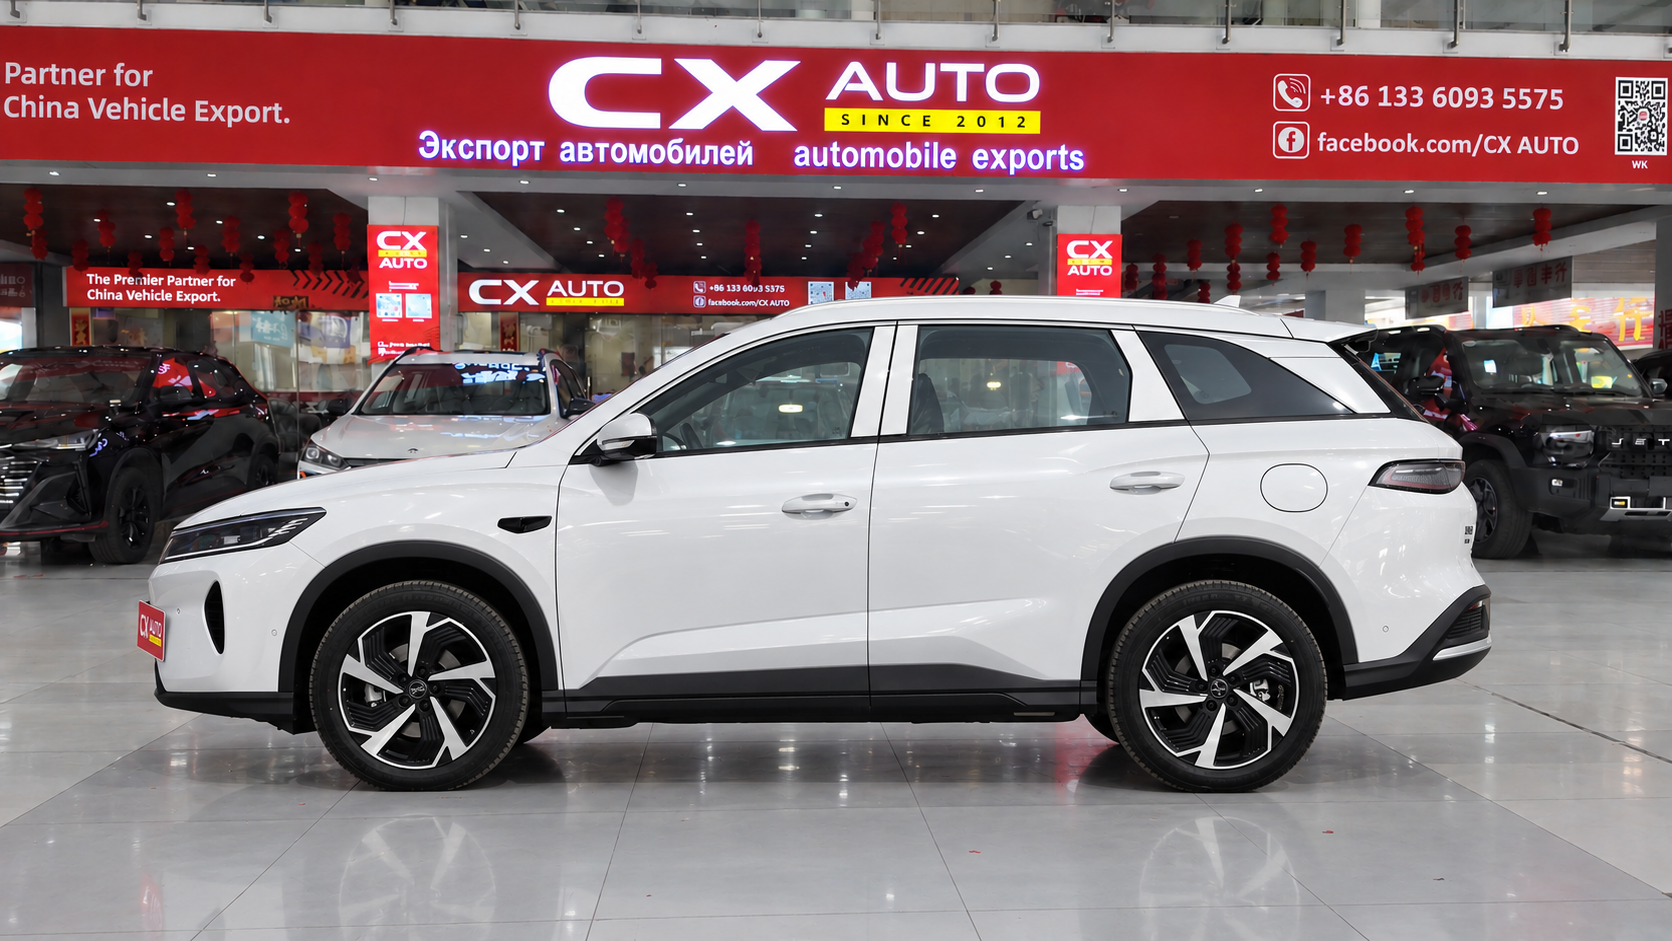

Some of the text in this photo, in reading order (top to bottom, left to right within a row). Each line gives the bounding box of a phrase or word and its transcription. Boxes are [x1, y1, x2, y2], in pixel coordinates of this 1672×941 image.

[5, 62, 154, 87] Partner for
[548, 56, 1040, 132] CX AUTO
[1321, 85, 1564, 110] +86 133 6093 5575
[3, 95, 290, 128] China Vehicle Export.
[841, 113, 1027, 128] SINCE 2012
[418, 130, 754, 167] Экспорт автомобилей
[1317, 132, 1579, 157] facebook.com/CX AUTO
[794, 141, 1085, 176] automobile exports
[1631, 160, 1648, 169] WK
[376, 230, 427, 250] CX
[1066, 240, 1113, 259] CX
[378, 257, 428, 269] AUTO
[1067, 265, 1113, 276] AUTO
[87, 273, 236, 287] The Premier Partner for
[709, 284, 725, 293] +86
[726, 284, 741, 293] 133
[87, 288, 221, 304] China Vehicle Export.
[468, 279, 625, 306] CX AUTO
[769, 299, 790, 307] AUTO
